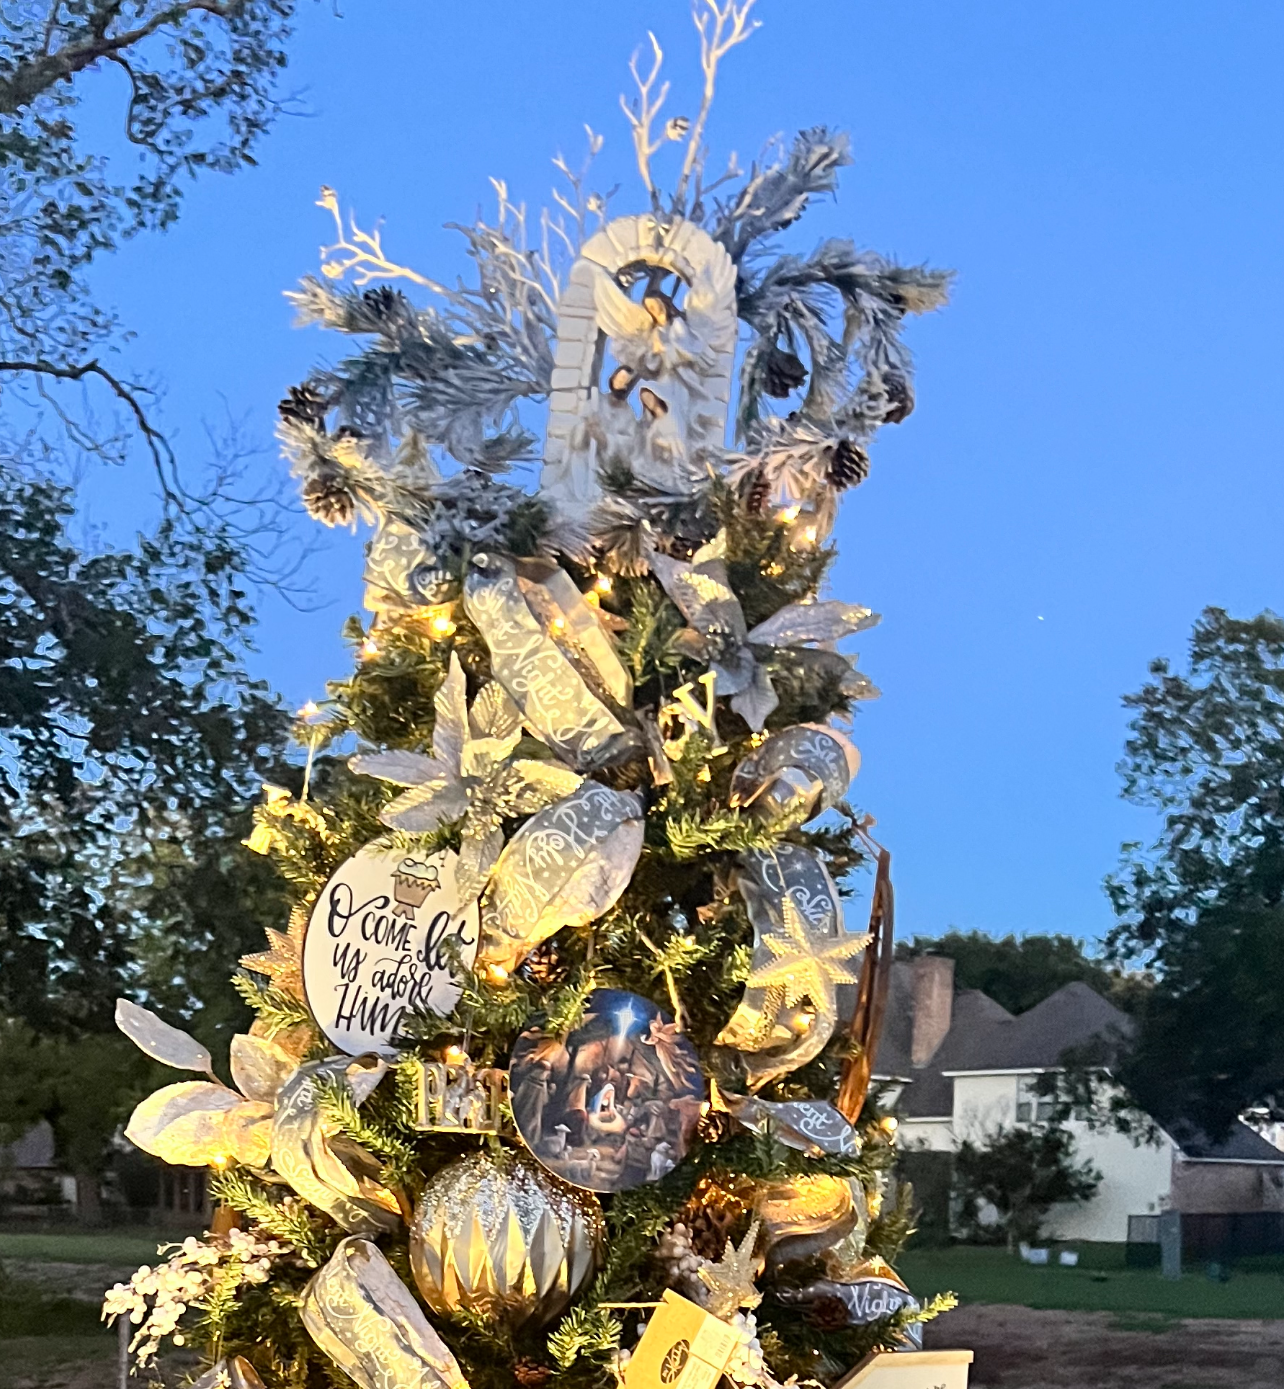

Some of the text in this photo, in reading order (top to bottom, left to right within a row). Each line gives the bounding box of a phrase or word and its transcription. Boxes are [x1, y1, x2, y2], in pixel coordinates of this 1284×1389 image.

[525, 806, 608, 868] Holy
[328, 883, 390, 938] O
[361, 911, 418, 952] COME
[333, 942, 434, 1003] us adore
